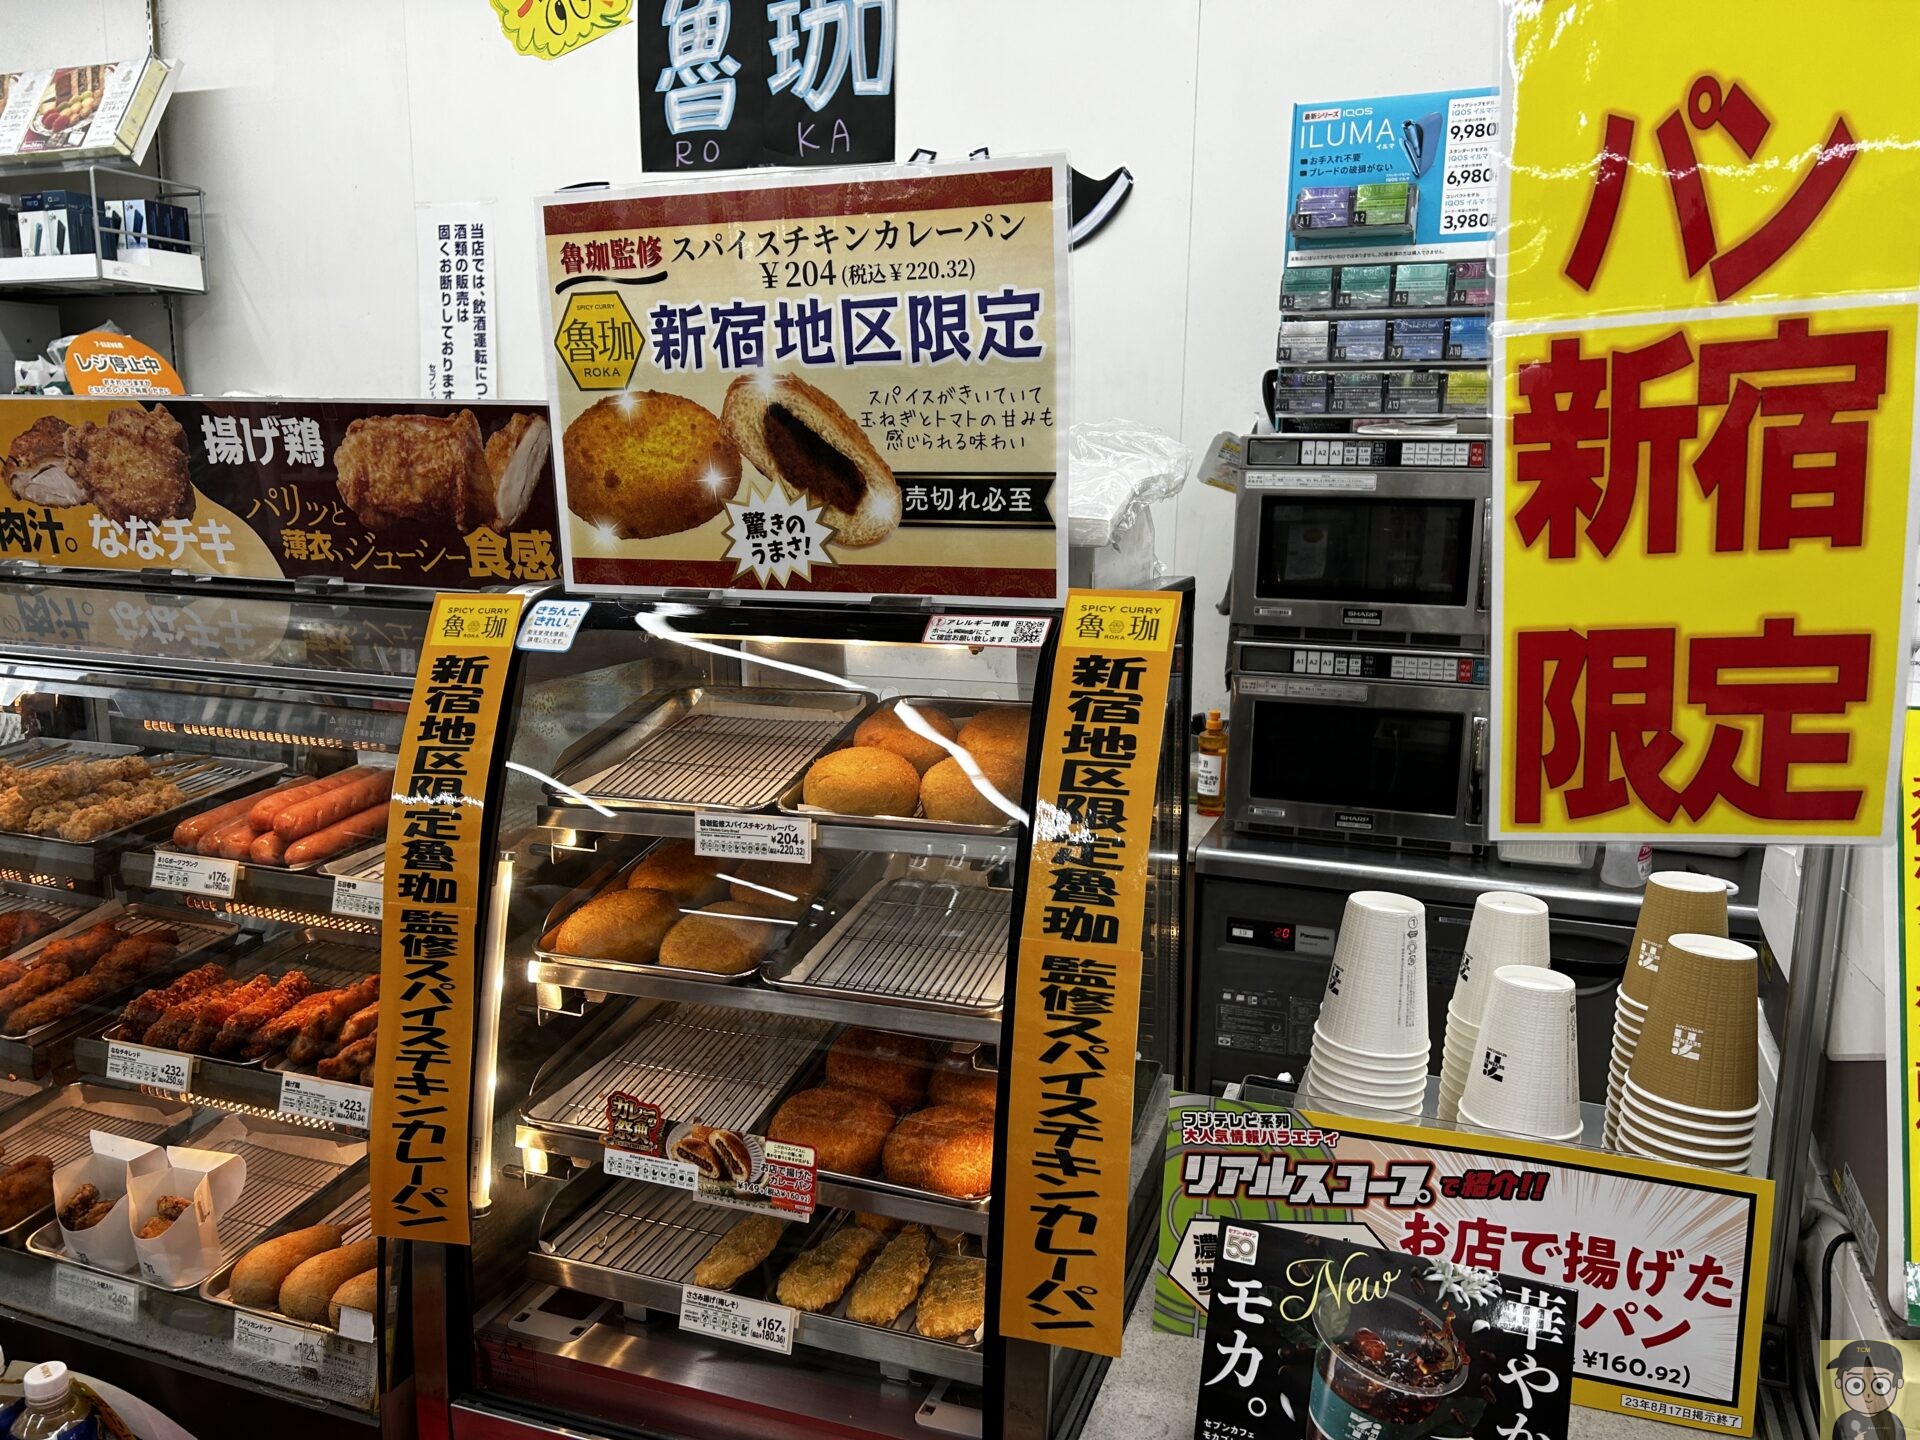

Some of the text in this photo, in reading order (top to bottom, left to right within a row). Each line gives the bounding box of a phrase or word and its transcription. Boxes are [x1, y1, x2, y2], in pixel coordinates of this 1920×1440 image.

[1304, 111, 1340, 121] 最新シリーズ
[1342, 107, 1373, 117] IQOS
[675, 118, 851, 166] RO KA
[1300, 118, 1395, 149] ILUMA
[1450, 122, 1497, 142] 9,980
[1309, 153, 1362, 166] お手入れ不要
[1308, 164, 1394, 178] ブレードの破損がない
[1446, 168, 1492, 187] 6,980
[1564, 74, 1856, 302] パン
[1353, 213, 1365, 223] A2
[1443, 213, 1489, 231] 3,980
[559, 213, 1026, 275] 魯珈監修 スパイスチキンカレーパン
[454, 224, 469, 323] 酒類の販売は
[761, 258, 977, 289] ¥204 (税込¥220.32)
[1282, 296, 1294, 306] A3
[1338, 294, 1350, 305] A4
[1395, 293, 1407, 303] A5
[1453, 291, 1465, 301] A6
[471, 223, 488, 399] 当店では、飲酒運転につ
[563, 317, 636, 363] 魯珈
[649, 289, 1044, 371] 新宿地区限定
[1279, 350, 1290, 360] A7
[1449, 345, 1461, 356] A10
[73, 353, 162, 375] レジ停止中
[583, 367, 622, 379] ROKA
[868, 387, 1042, 407] スパイスがきいていて
[1332, 400, 1344, 410] A12
[1387, 400, 1400, 410] A13
[860, 408, 1055, 430] 玉ねぎとトマトの甘みも
[200, 414, 325, 468] 揚げ鶏
[885, 430, 1026, 452] 感じられる味わい
[1513, 317, 1889, 559] 新宿
[246, 484, 347, 527] パリッと
[905, 485, 1034, 513] 売切れ必至
[741, 512, 806, 542] 驚きの
[88, 513, 236, 564] ななチキ
[751, 536, 811, 564] うまさ!
[478, 607, 510, 615] CURRY
[536, 606, 582, 617] きちんと、
[1080, 604, 1162, 615] SPICY CURRY
[442, 614, 507, 639] 魯珈
[534, 616, 570, 628] きれい。
[946, 619, 1011, 628] アレルギー情報
[1075, 612, 1160, 641] 魯珈
[1513, 617, 1873, 825] 限定
[1339, 814, 1370, 822] SHARP
[771, 832, 799, 845] ¥204
[208, 871, 228, 883] ¥176
[1300, 932, 1330, 941] Panasonic
[161, 1064, 182, 1077] ¥232
[340, 1099, 362, 1112] ¥223
[1182, 1111, 1291, 1130] フジテレビ系列
[1182, 1128, 1340, 1149] 大人気情報バラエティ
[760, 1163, 813, 1182] お店で揚げた
[1184, 1154, 1550, 1205] リアルスコープ で紹介!!
[769, 1175, 813, 1192] カレーパン
[1226, 1234, 1256, 1260] 50
[1400, 1211, 1735, 1308] お店で揚げた
[1279, 1251, 1402, 1322] New
[686, 1290, 739, 1310] ささみ揚げ(梅しそ)
[757, 1317, 782, 1332] ¥167
[1204, 1278, 1273, 1417] モカ。
[1624, 1396, 1742, 1428] 23年8月17日掲示終了
[1203, 1418, 1255, 1439] セブンカフェ
